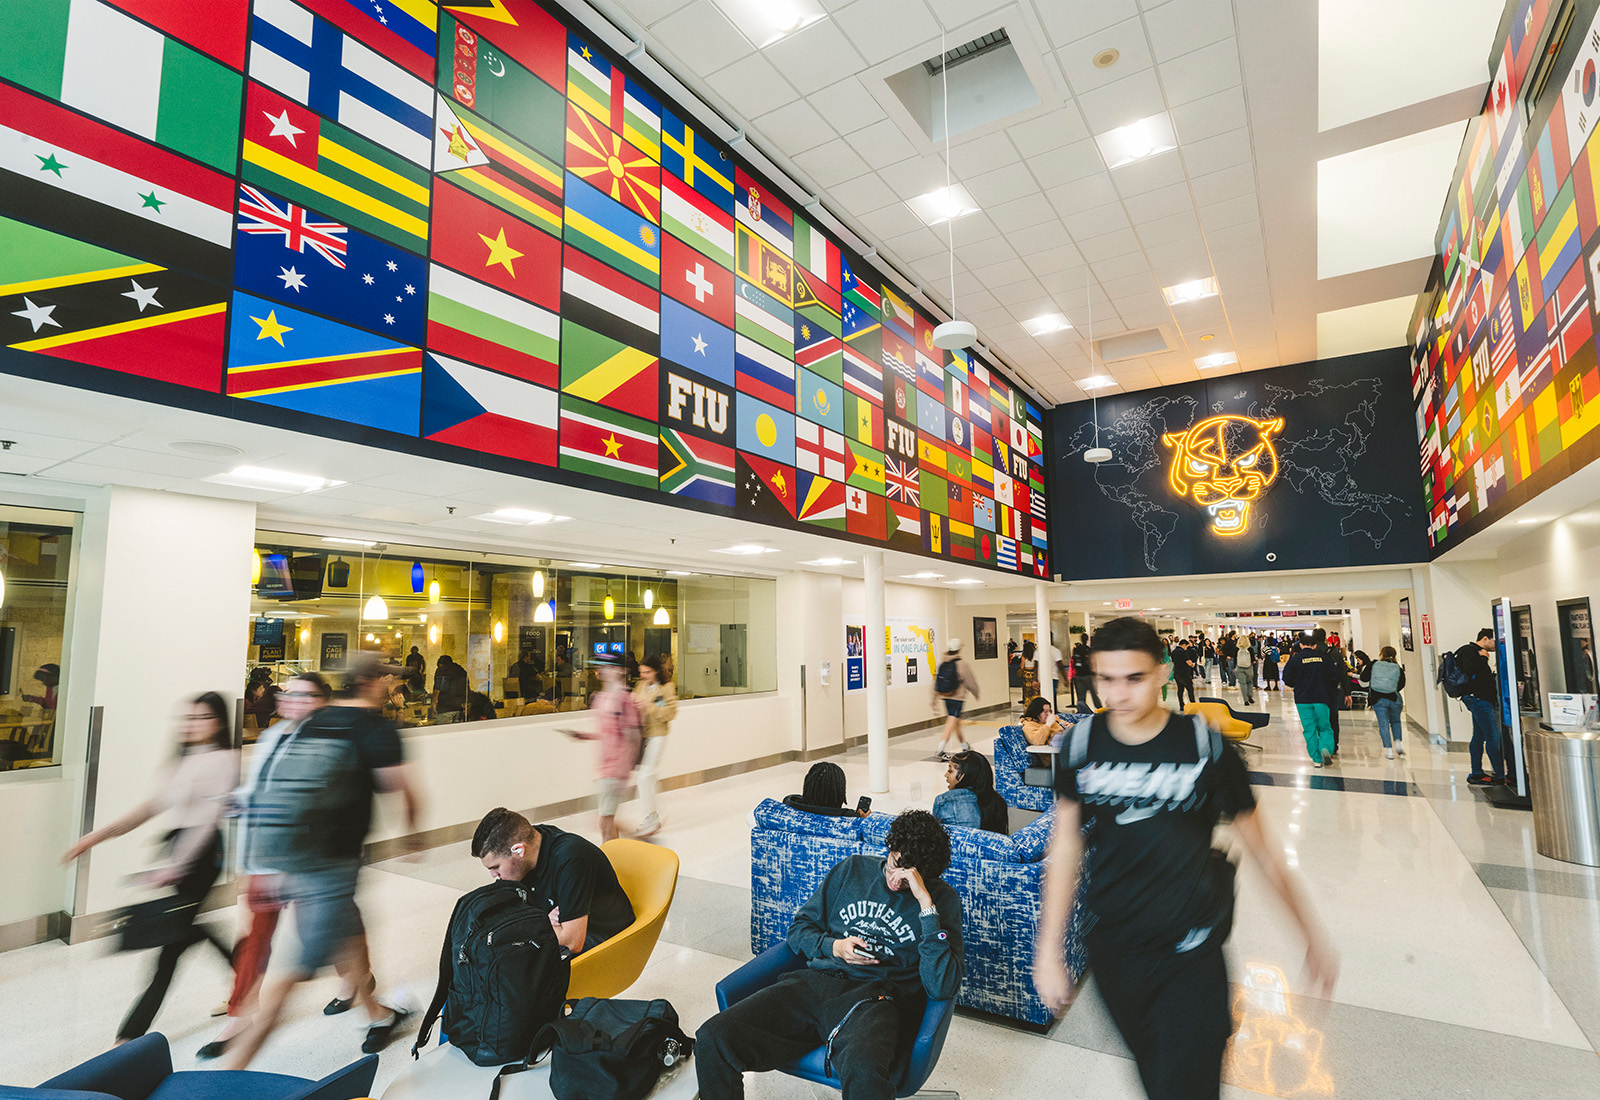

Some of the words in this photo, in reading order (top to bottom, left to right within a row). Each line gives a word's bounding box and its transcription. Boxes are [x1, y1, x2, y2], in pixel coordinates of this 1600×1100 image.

[1473, 336, 1490, 392] FIU
[668, 371, 729, 435] FIU
[887, 418, 915, 459] FIU
[1012, 453, 1028, 480] FIU
[1118, 600, 1131, 608] EXIT
[893, 644, 900, 653] IN
[901, 643, 913, 653] ONE
[908, 665, 917, 675] FIU
[839, 900, 916, 943] SOUTHEAST
